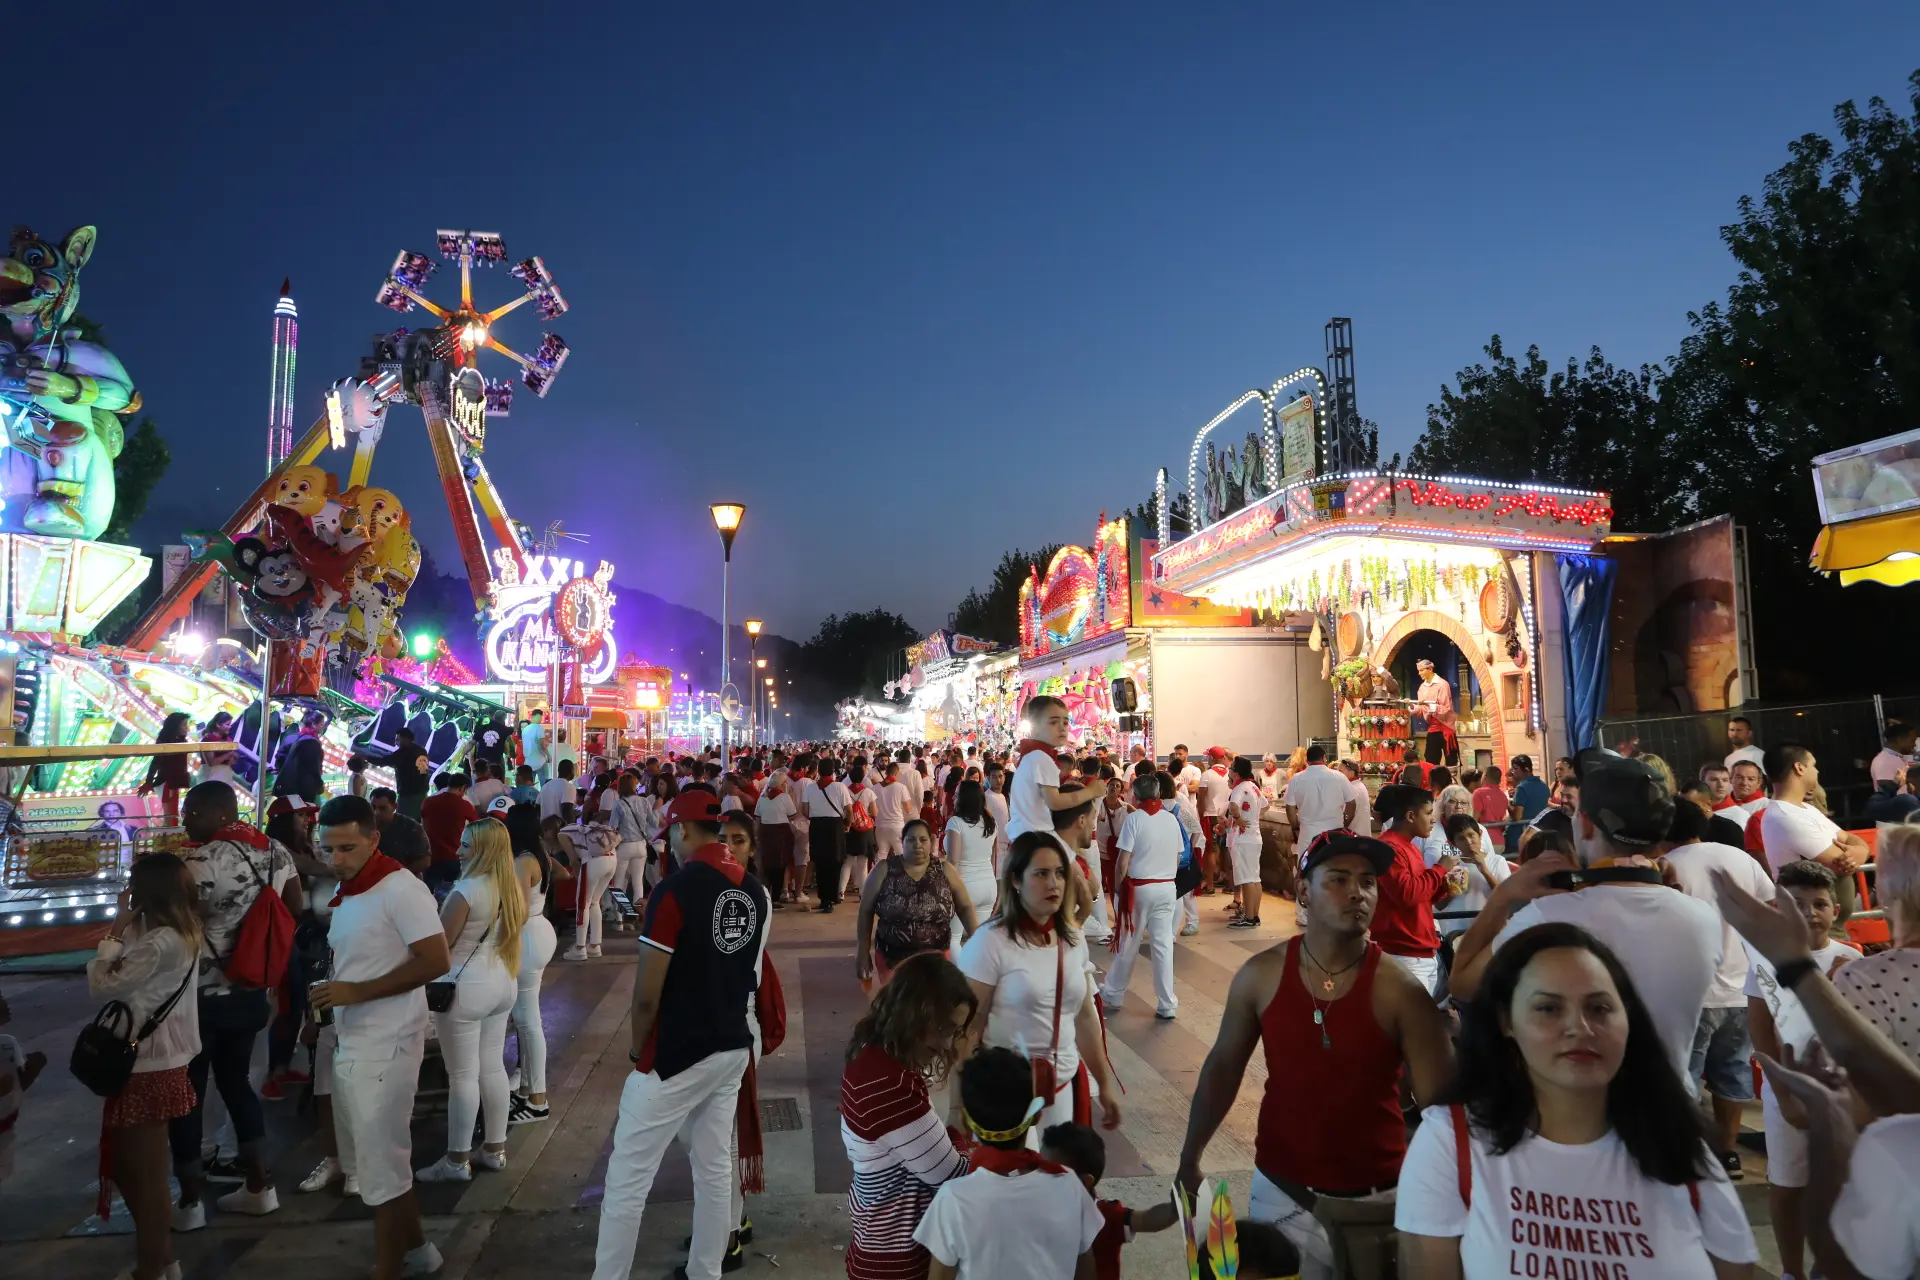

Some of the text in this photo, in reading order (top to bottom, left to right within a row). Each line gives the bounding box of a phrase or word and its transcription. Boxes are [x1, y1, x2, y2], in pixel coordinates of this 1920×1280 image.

[1394, 479, 1491, 511] Vino
[726, 892, 753, 909] CHALLENGE
[1510, 1186, 1642, 1227] SARCASTIC
[1511, 1218, 1655, 1259] COMMENTS
[1510, 1249, 1629, 1280] LOADING
